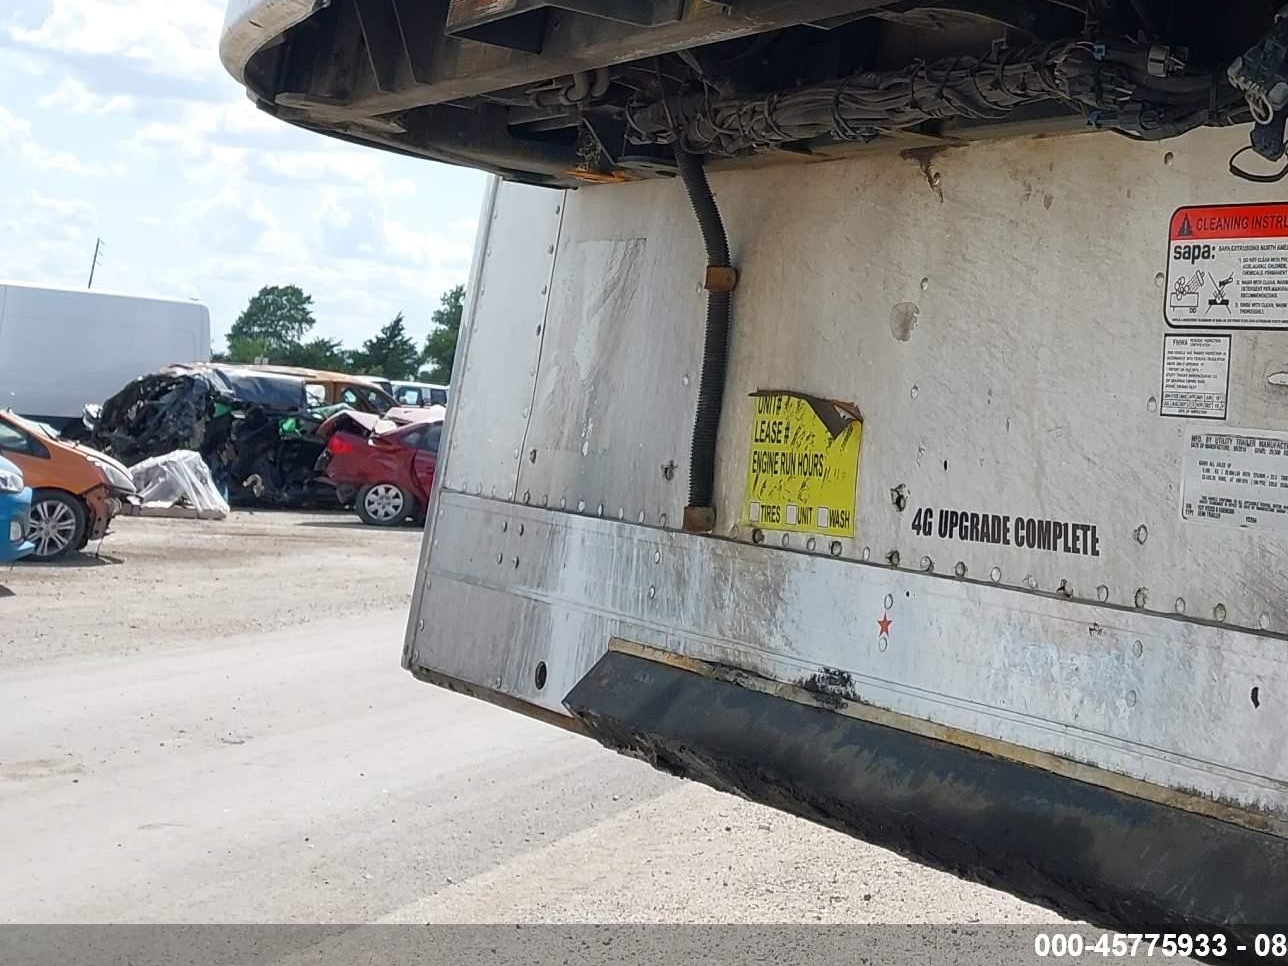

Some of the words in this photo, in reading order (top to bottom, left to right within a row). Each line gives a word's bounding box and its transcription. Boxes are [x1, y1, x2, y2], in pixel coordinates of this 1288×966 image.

[1196, 216, 1248, 230] CLEANING
[755, 419, 782, 443] LEASE
[783, 421, 789, 444] #
[1215, 436, 1232, 445] UTILITY
[1236, 438, 1255, 446] TRAILER
[752, 450, 778, 474] ENGINE
[780, 451, 795, 474] RUN
[798, 452, 823, 476] HOURS
[760, 504, 780, 523] TIRES
[797, 506, 812, 524] UNIT
[829, 509, 849, 528] WASH
[912, 507, 934, 536] 4G
[938, 508, 1010, 546] UPGRADE
[1015, 517, 1100, 557] COMPLETE
